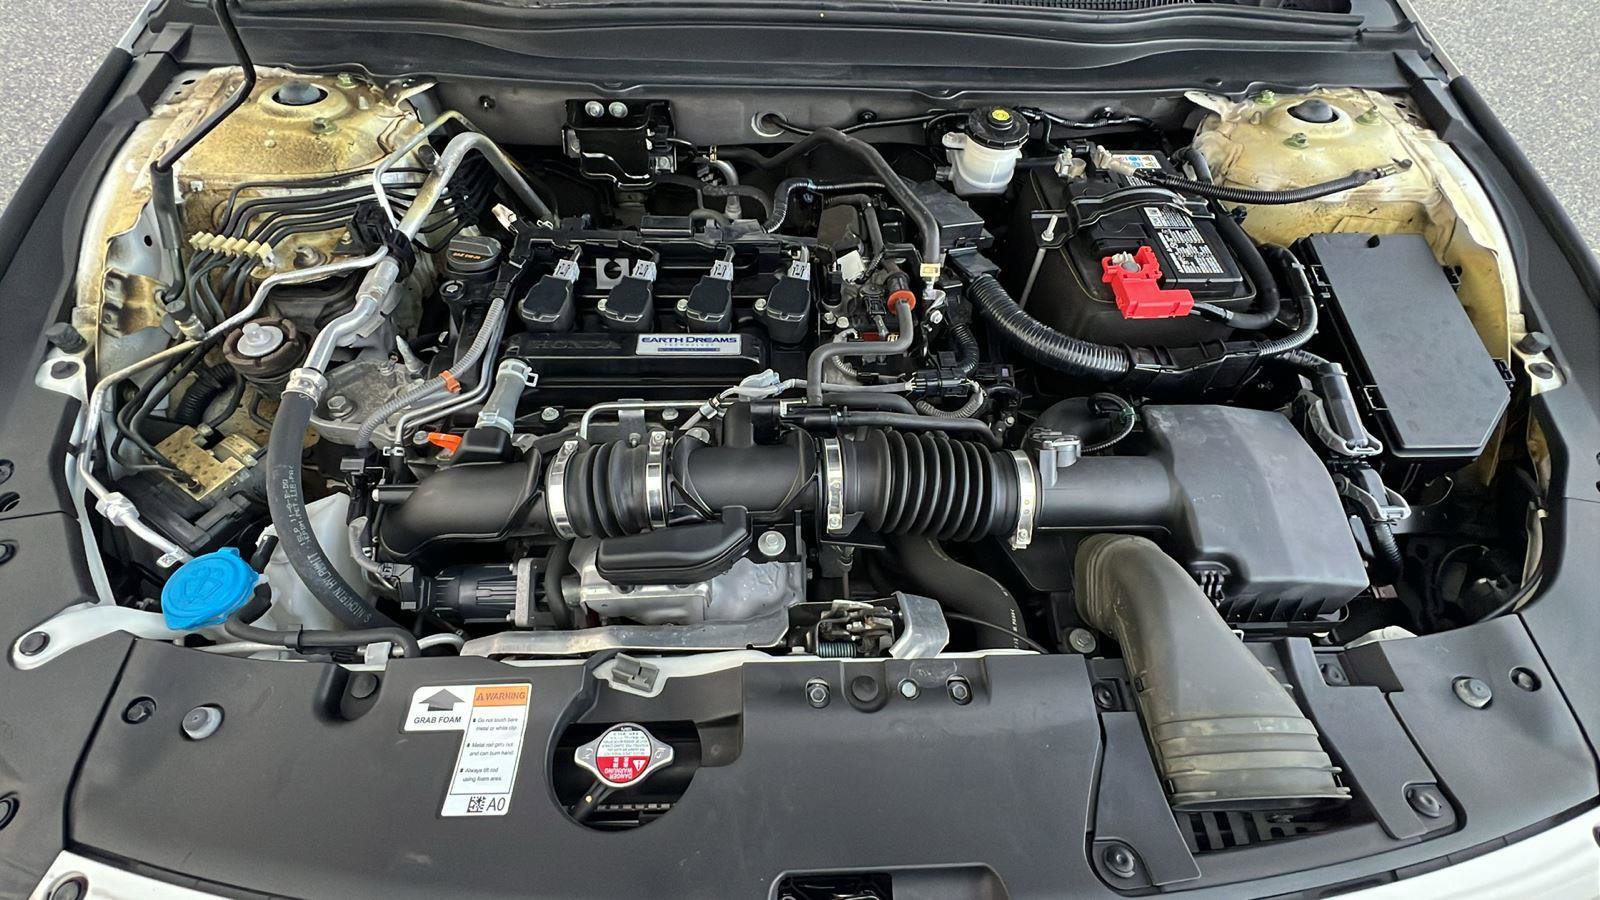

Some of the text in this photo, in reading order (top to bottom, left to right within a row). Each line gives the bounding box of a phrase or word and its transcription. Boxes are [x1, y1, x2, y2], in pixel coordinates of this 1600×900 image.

[486, 691, 526, 701] WARNING
[414, 716, 462, 724] GRAB FOAM
[486, 797, 506, 812] A0
